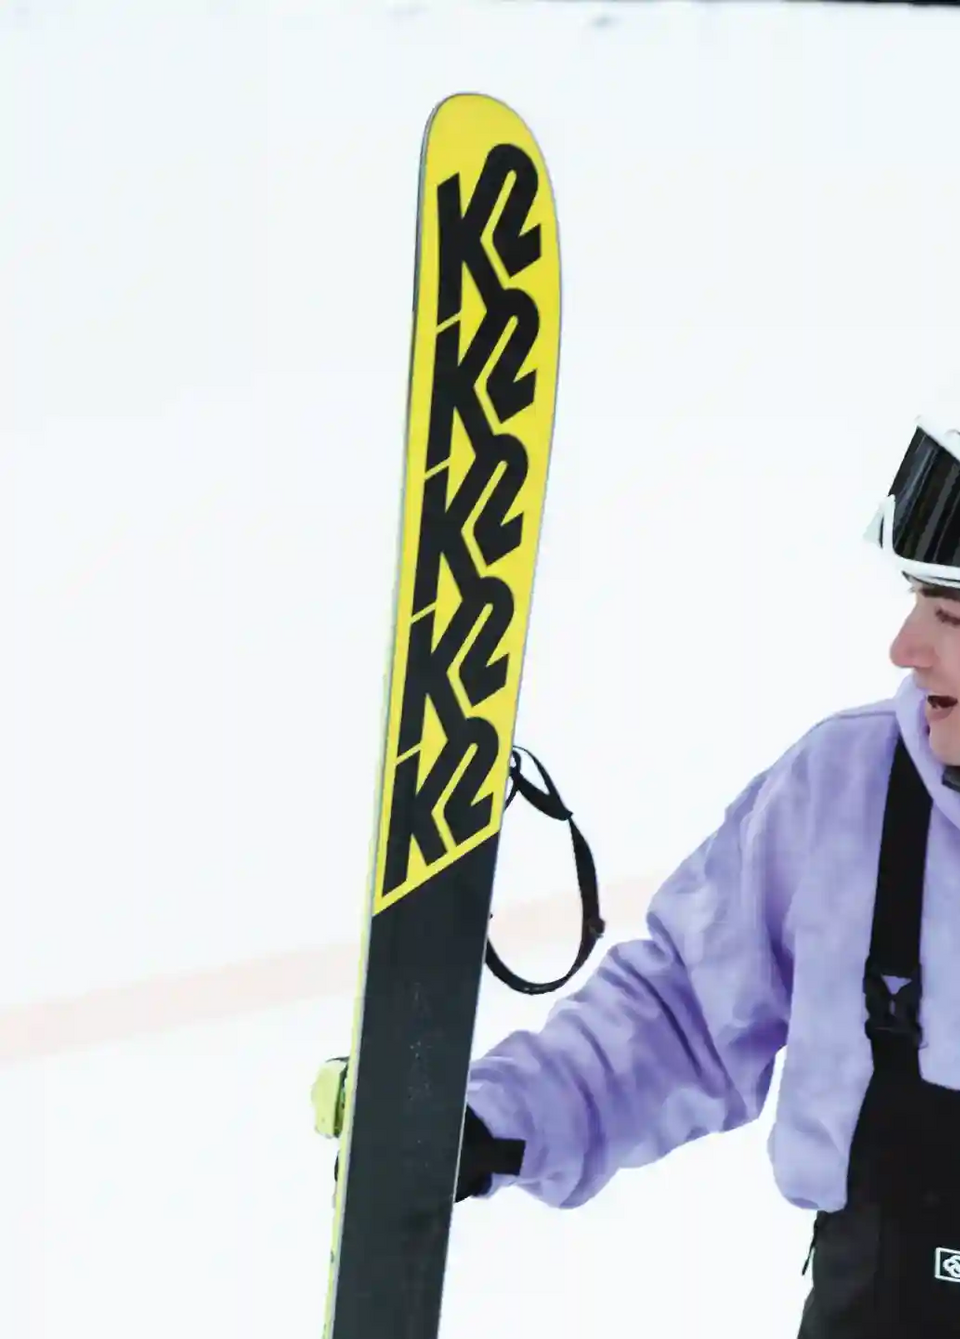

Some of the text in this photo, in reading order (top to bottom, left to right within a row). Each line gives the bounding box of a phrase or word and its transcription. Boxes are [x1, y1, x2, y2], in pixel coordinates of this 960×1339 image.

[437, 143, 541, 325] K2
[425, 288, 540, 472] K2
[411, 433, 528, 618] K2
[397, 576, 514, 757] K2
[382, 716, 499, 897] K2
